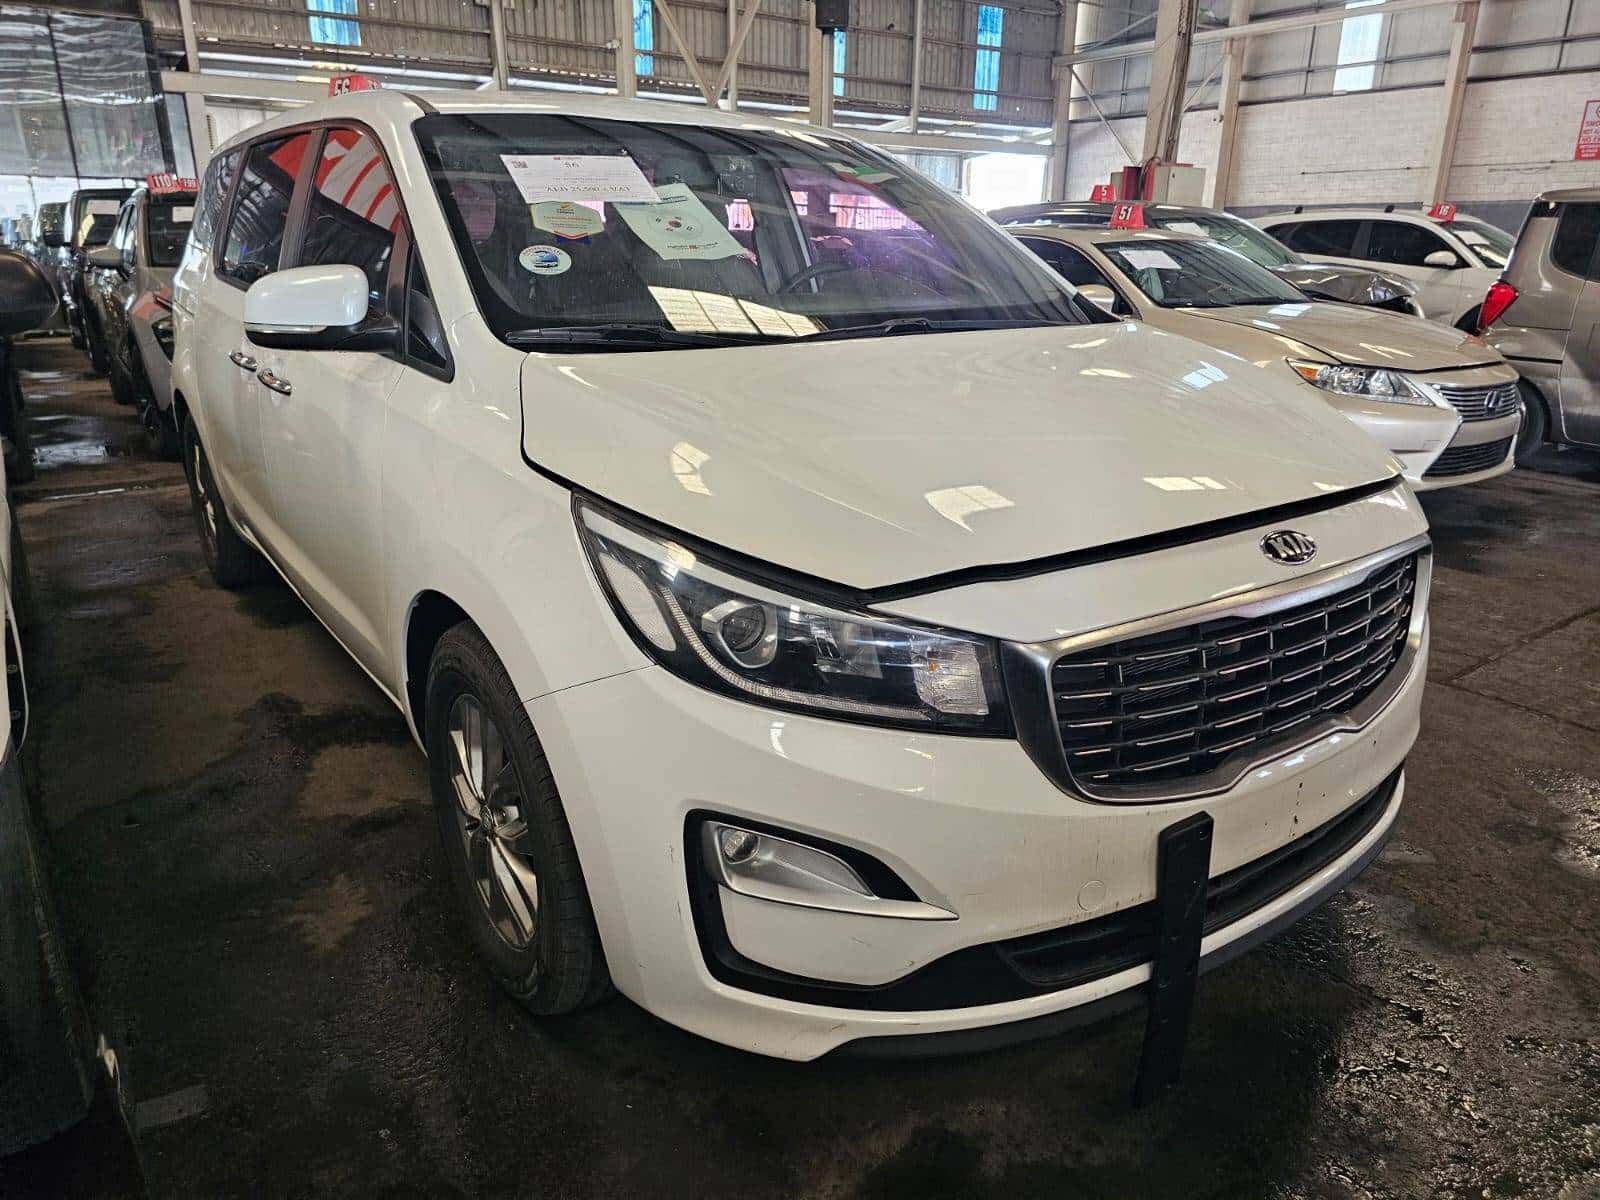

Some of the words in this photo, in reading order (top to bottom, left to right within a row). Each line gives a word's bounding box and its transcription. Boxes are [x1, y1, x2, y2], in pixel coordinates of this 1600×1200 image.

[152, 175, 171, 188] 110
[1101, 185, 1107, 197] 5
[1119, 206, 1133, 220] 51
[1265, 533, 1314, 559] KIA
